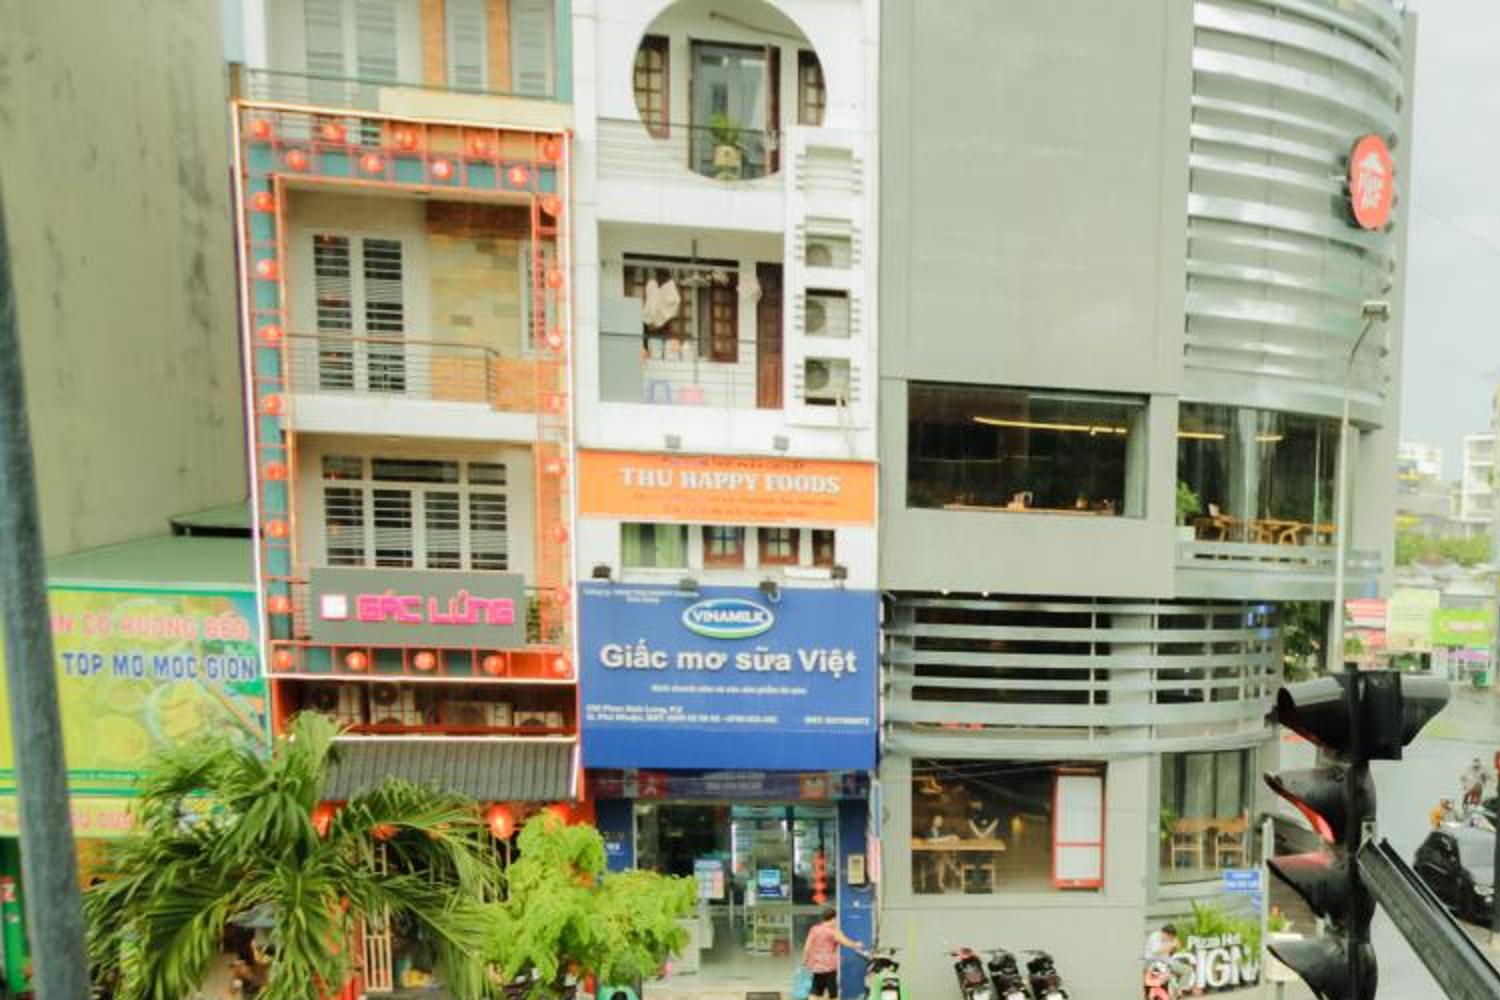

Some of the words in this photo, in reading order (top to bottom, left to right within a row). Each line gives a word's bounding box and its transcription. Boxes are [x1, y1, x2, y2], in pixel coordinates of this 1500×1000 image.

[620, 466, 674, 488] THU
[680, 470, 758, 493] HAPPY
[764, 473, 841, 495] FOODS
[692, 609, 766, 626] VINAMILK
[600, 638, 669, 670] Giấc
[676, 649, 729, 671] mơ
[735, 645, 792, 672] sữa
[797, 647, 858, 679] Việt
